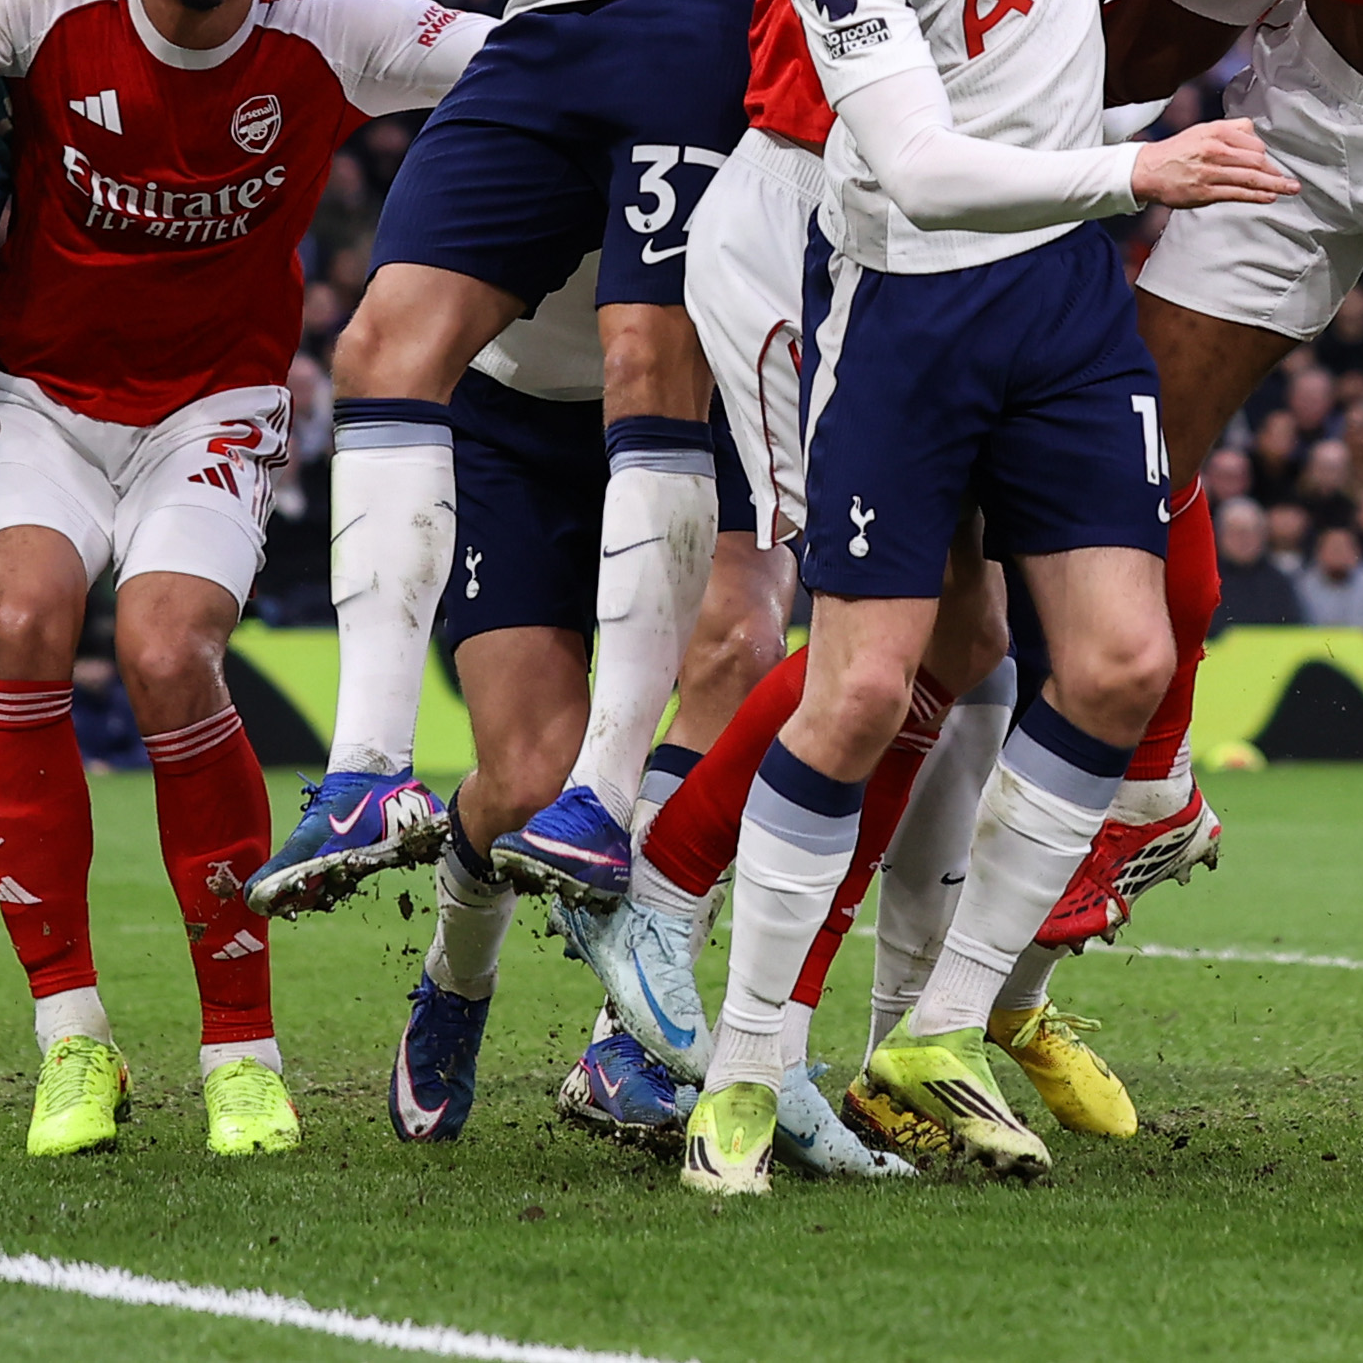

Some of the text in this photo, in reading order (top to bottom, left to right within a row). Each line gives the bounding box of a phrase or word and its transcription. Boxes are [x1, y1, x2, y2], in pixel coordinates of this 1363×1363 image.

[841, 19, 881, 42] room
[842, 28, 891, 53] racism
[239, 103, 274, 124] Arsenal
[62, 145, 287, 219] Emirates
[1130, 394, 1171, 486] 1
